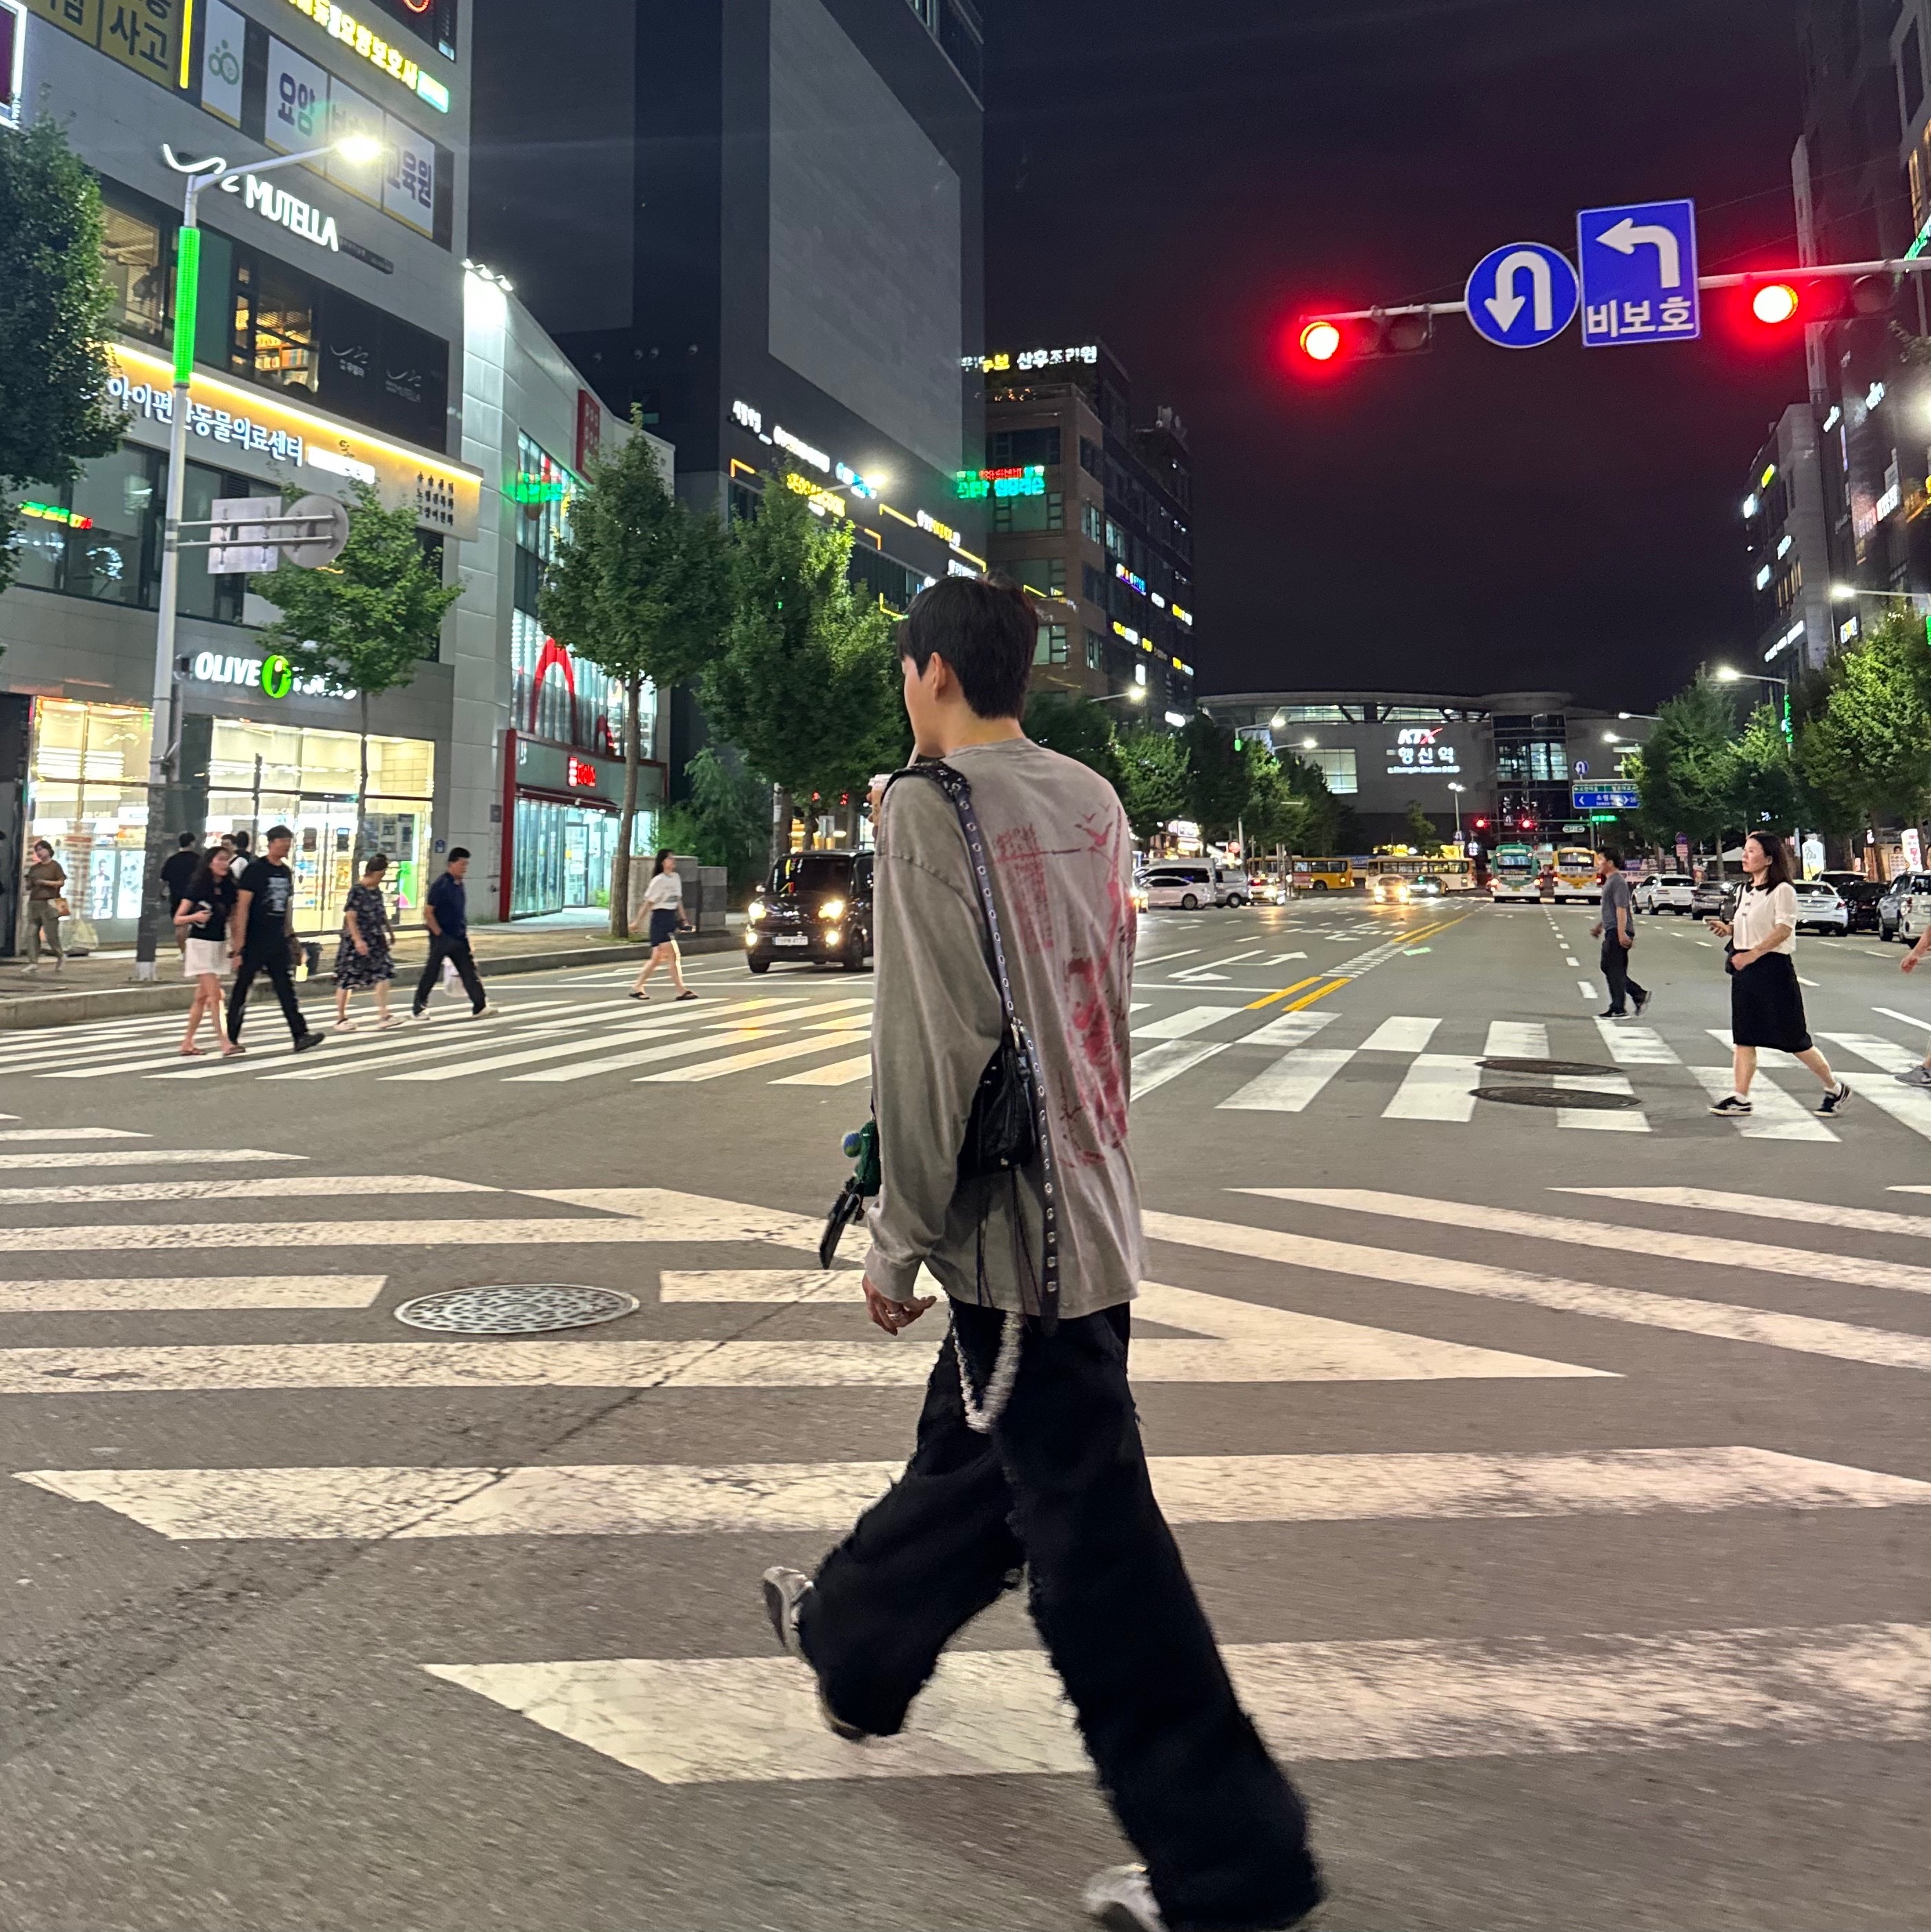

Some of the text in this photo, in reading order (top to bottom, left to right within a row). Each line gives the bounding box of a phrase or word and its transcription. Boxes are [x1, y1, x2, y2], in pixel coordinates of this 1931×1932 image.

[246, 174, 339, 253] MUTELLA
[1587, 296, 1694, 337] 비보호
[195, 651, 262, 687] OLIVE
[1397, 727, 1443, 745] KTX
[1398, 747, 1454, 765] 행신역
